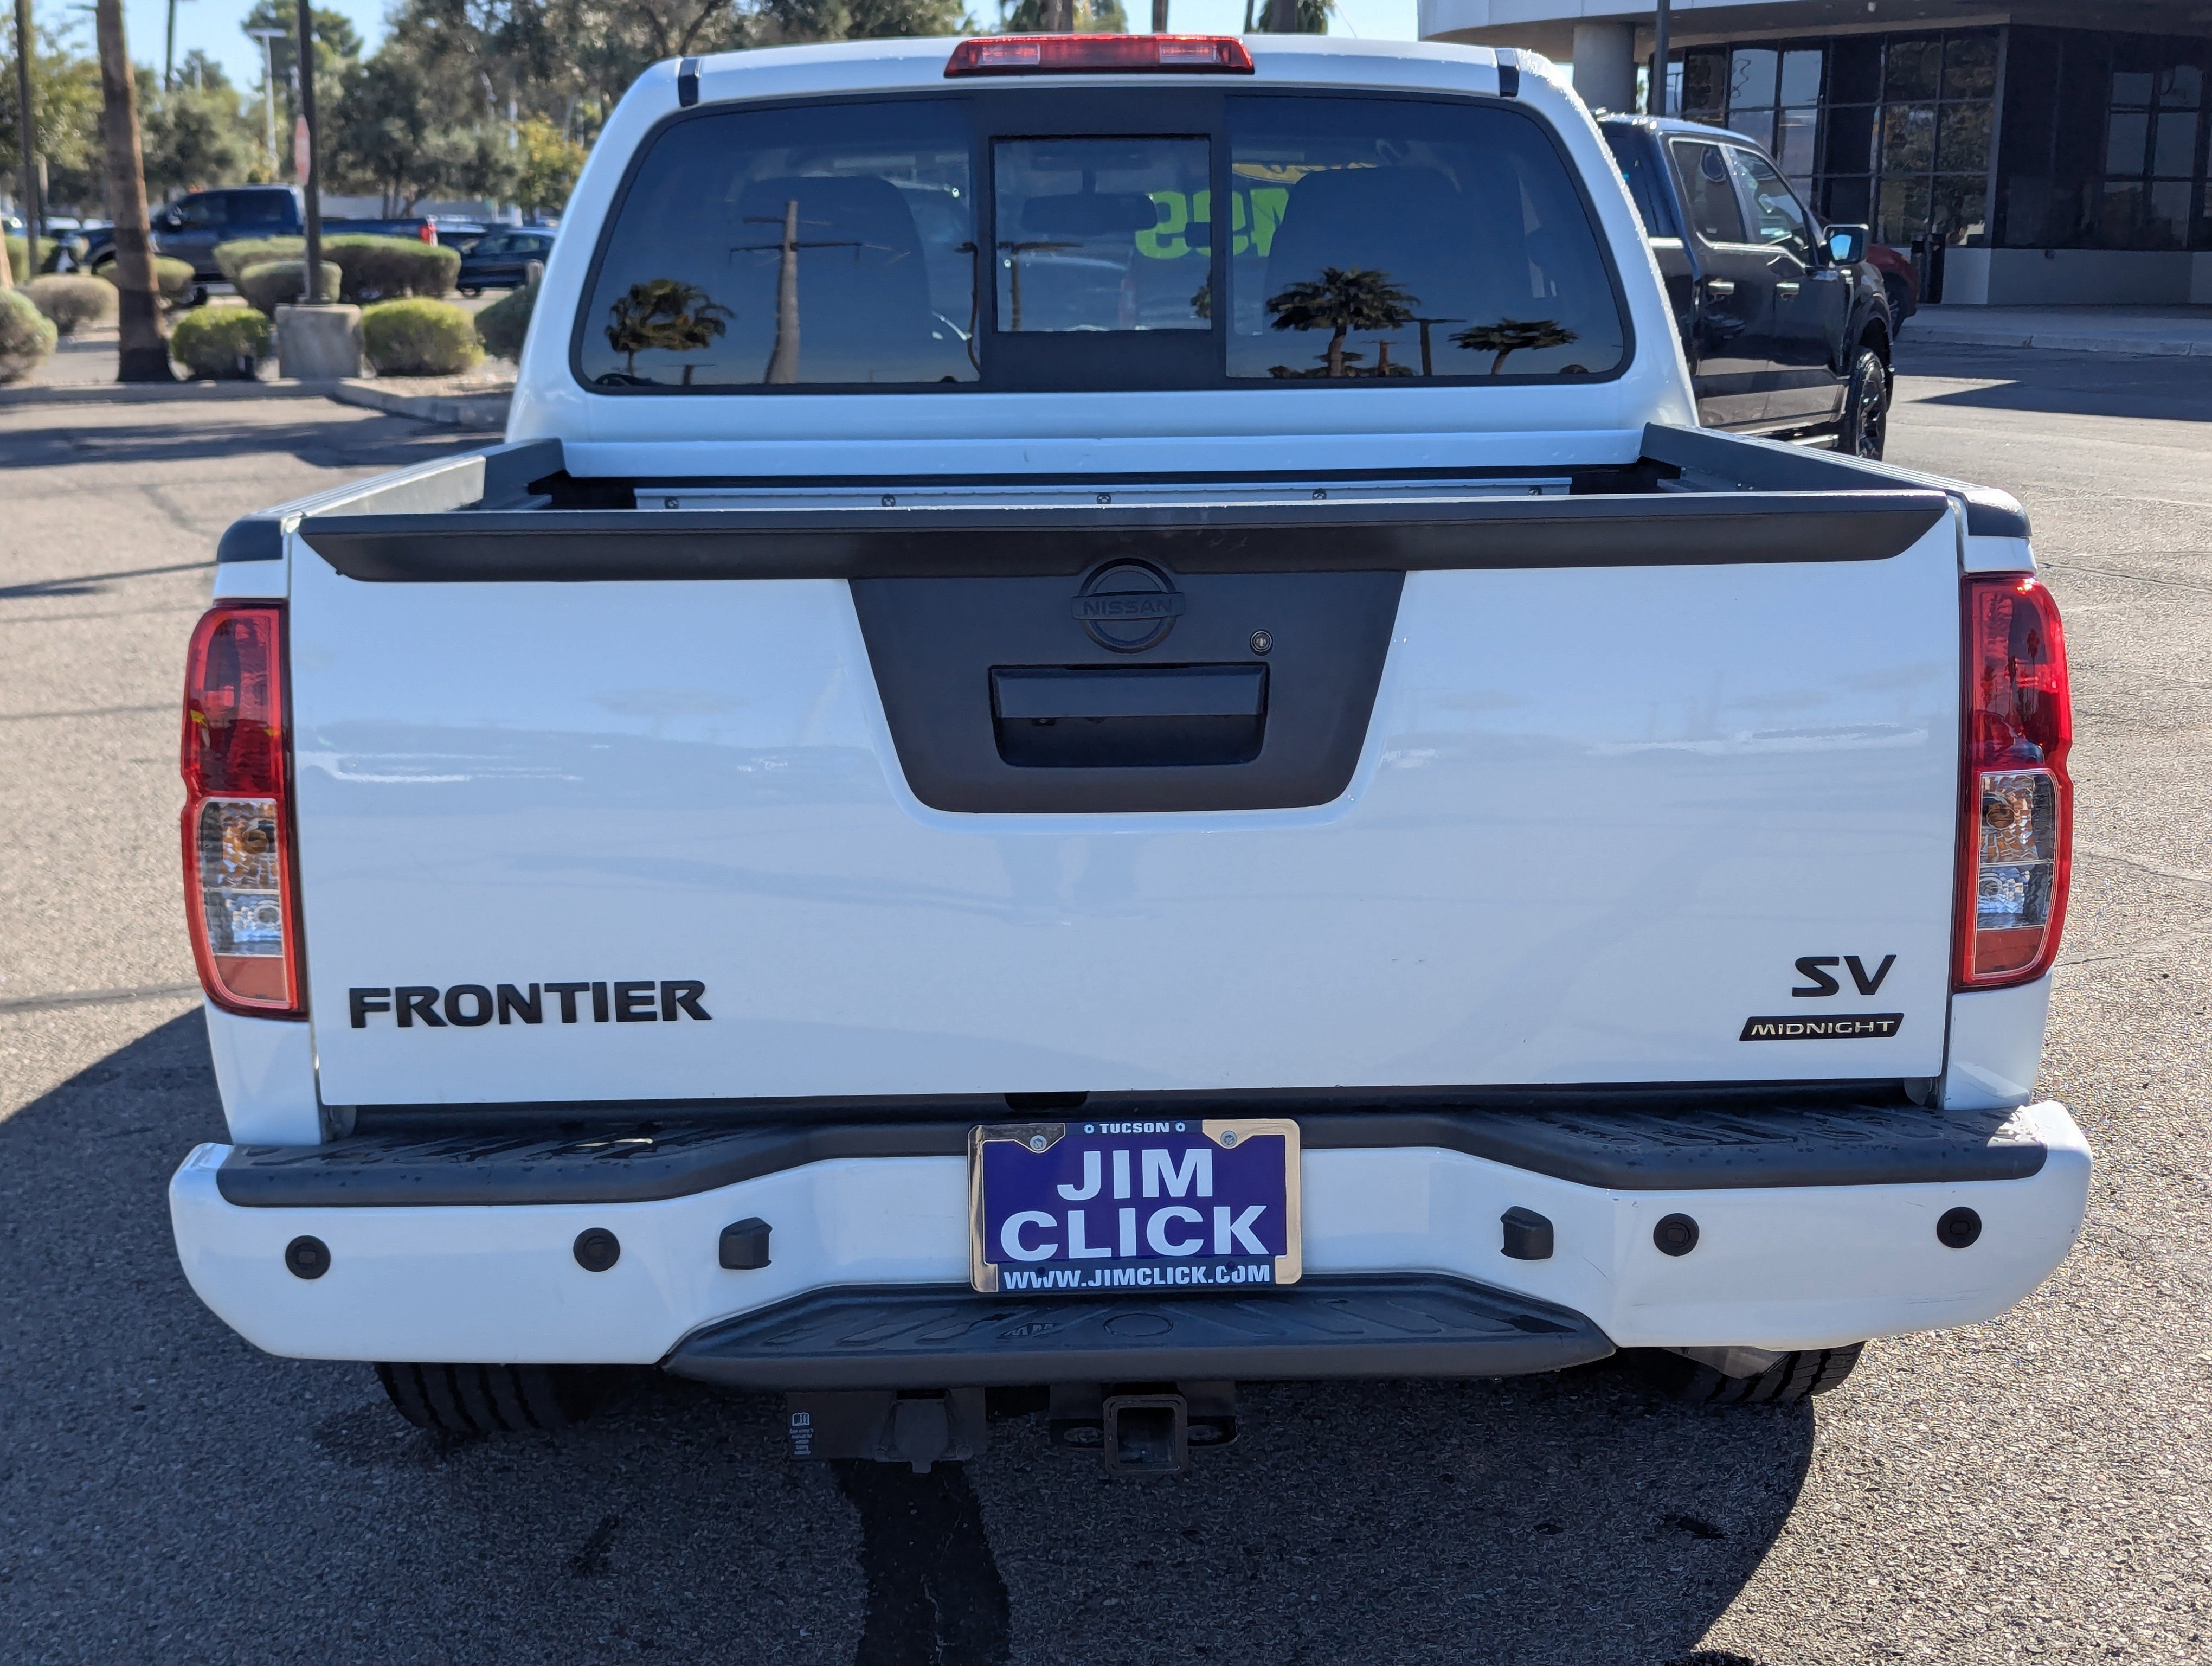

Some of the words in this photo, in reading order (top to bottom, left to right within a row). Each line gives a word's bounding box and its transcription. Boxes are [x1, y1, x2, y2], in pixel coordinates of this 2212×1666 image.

[1084, 598, 1172, 615] NISSAN
[1792, 954, 1897, 997] SV
[349, 980, 712, 1028] FRONTIER
[1751, 1021, 1895, 1035] MIDNIGHT
[1099, 1122, 1169, 1134] TUCSON
[1057, 1149, 1213, 1201] JIM
[1000, 1205, 1270, 1261] CLICK
[1004, 1265, 1270, 1289] WWW.JIMCLICK.COM
